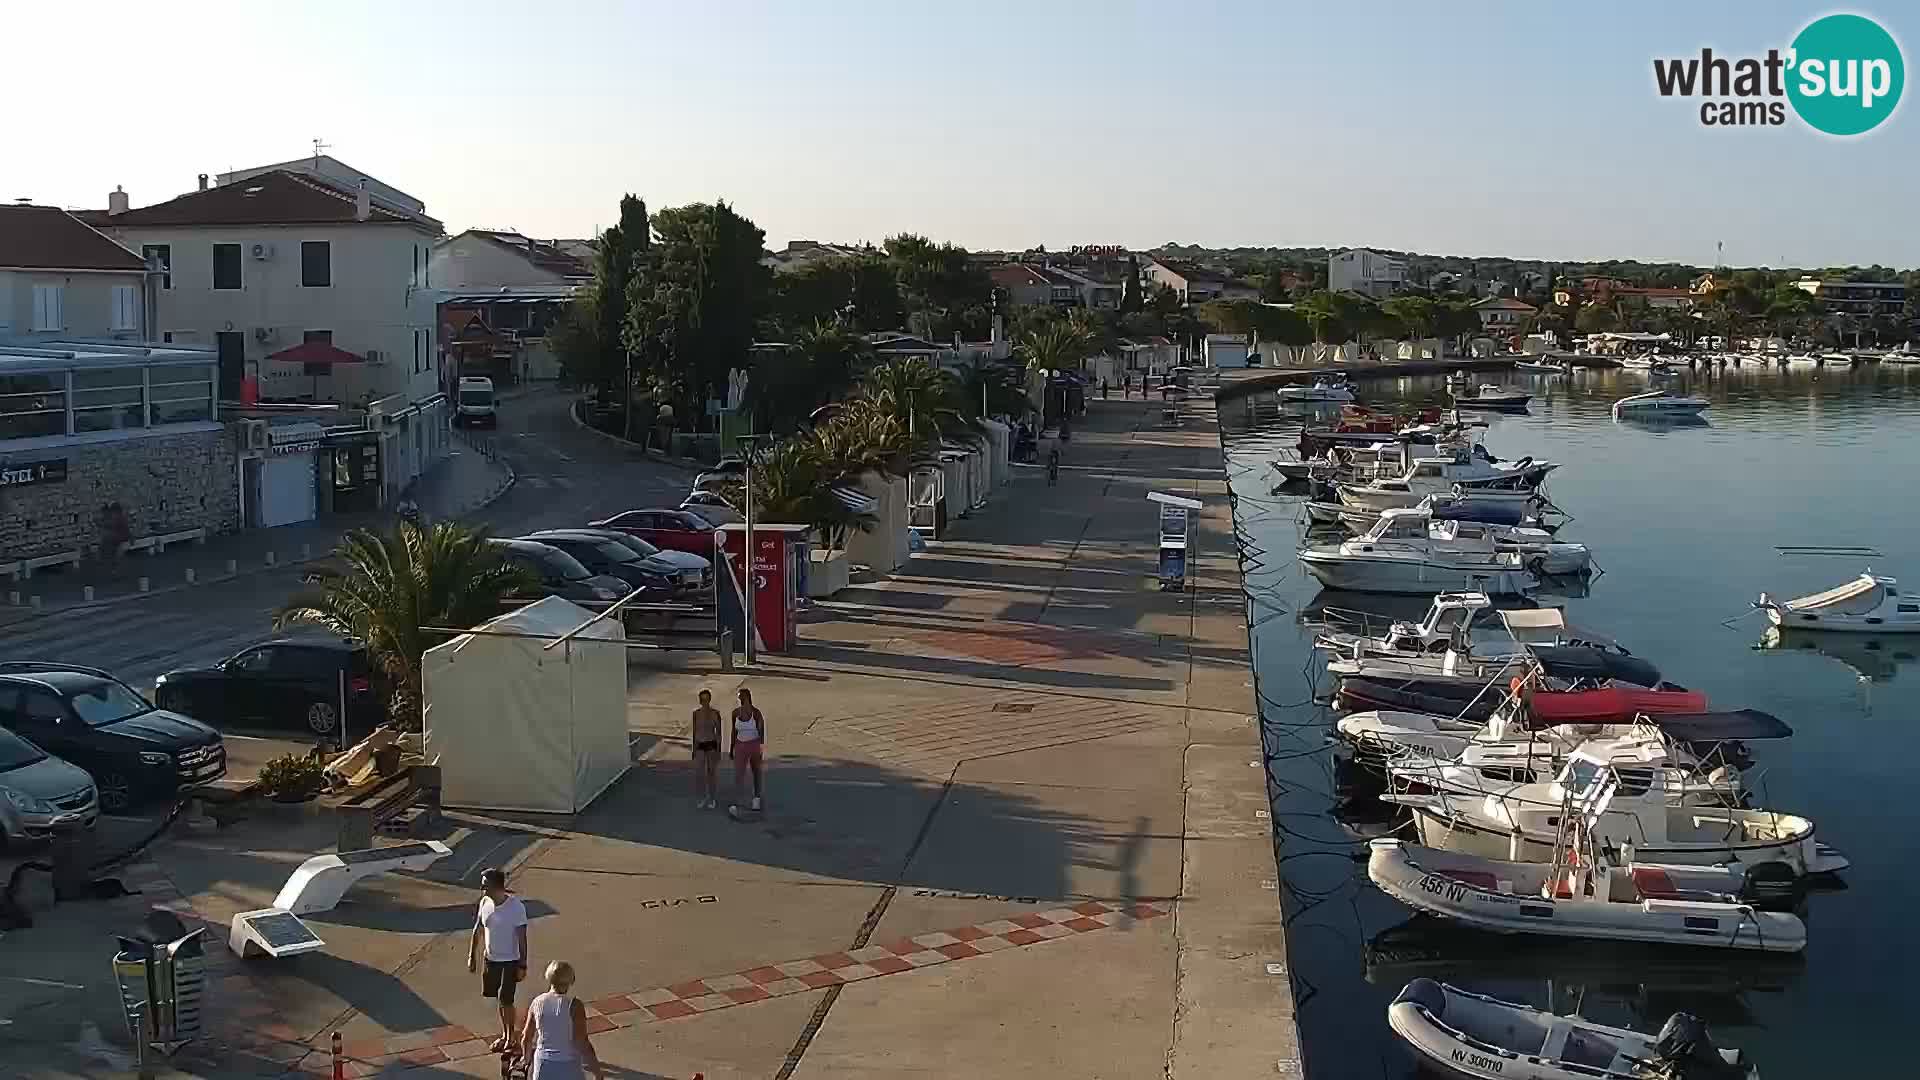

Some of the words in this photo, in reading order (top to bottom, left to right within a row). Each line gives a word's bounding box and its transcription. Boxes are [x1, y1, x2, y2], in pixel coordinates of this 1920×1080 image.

[1420, 876, 1443, 895] 456
[1446, 884, 1467, 902] NV
[1451, 1048, 1467, 1061] NV
[1468, 1053, 1503, 1072] 300110
